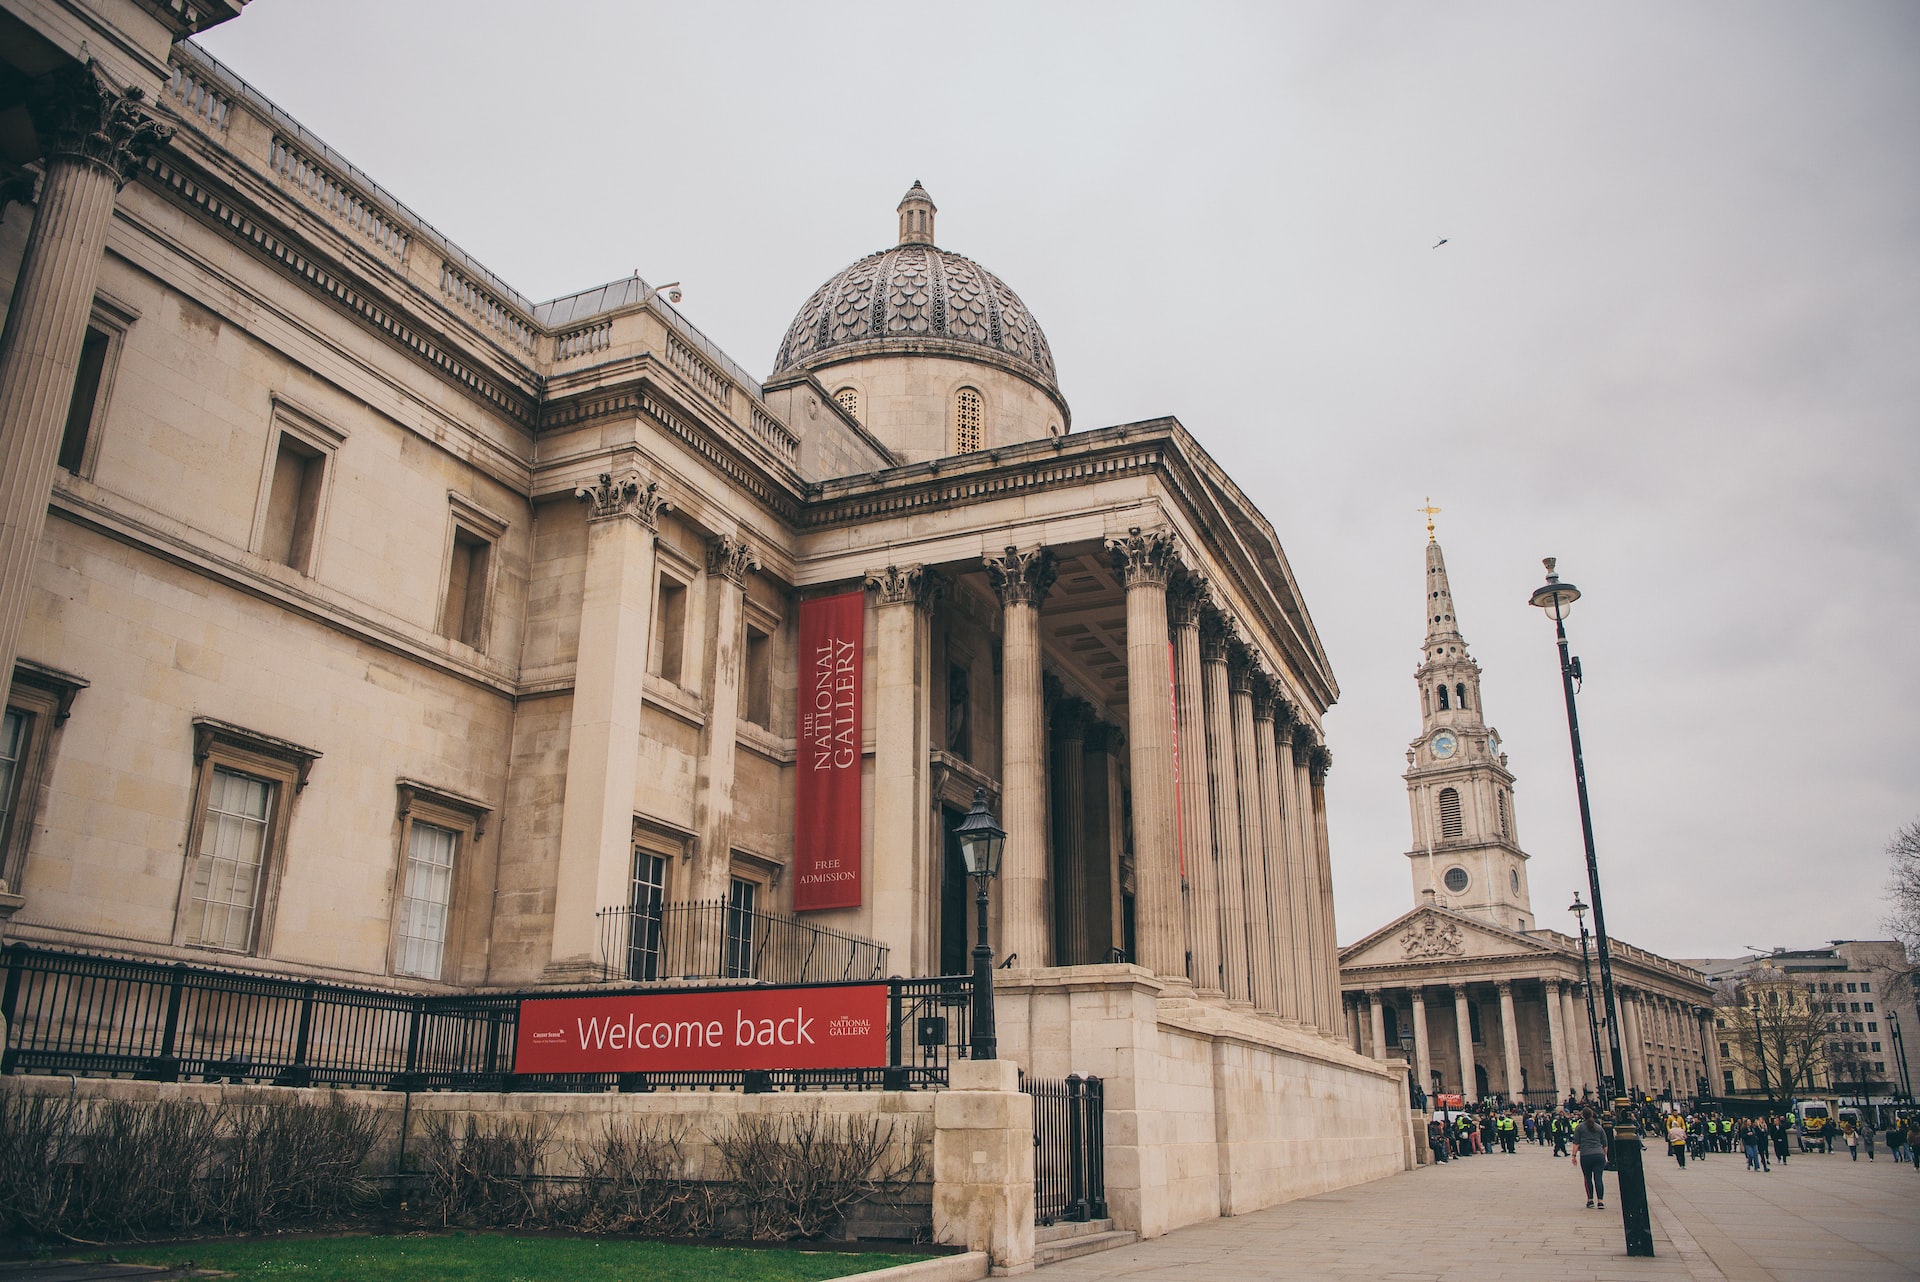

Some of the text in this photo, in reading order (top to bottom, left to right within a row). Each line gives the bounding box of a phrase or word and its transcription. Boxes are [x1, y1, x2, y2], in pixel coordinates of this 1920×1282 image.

[814, 638, 832, 771] NATIONAL
[834, 637, 855, 769] GALLERY
[804, 713, 813, 739] THE
[815, 859, 841, 870] FREE
[800, 871, 856, 884] ADMISSION
[577, 1007, 815, 1050] Welcome back
[829, 1026, 871, 1036] GALLERY
[830, 1019, 871, 1028] NATIONAL
